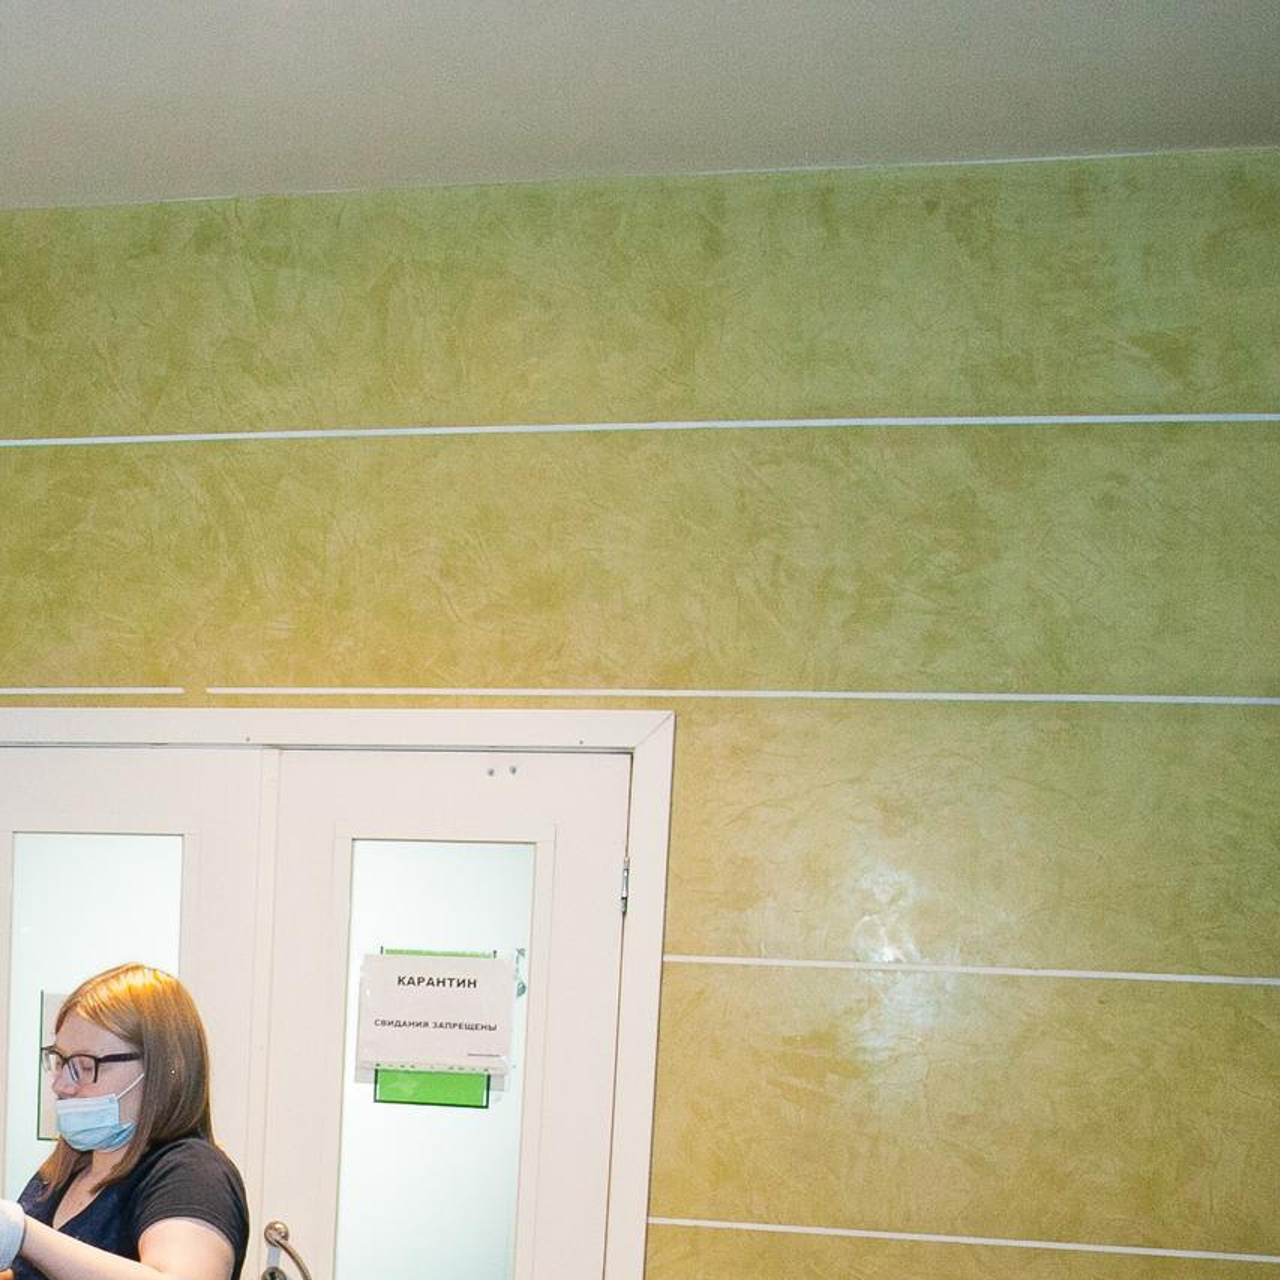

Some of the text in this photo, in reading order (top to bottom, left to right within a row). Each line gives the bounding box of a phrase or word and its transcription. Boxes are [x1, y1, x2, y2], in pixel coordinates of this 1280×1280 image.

[397, 976, 477, 988] КАРАНТИН
[374, 1019, 497, 1031] СВИДАНИЯ ЗАПРЕЩЕНЫ
